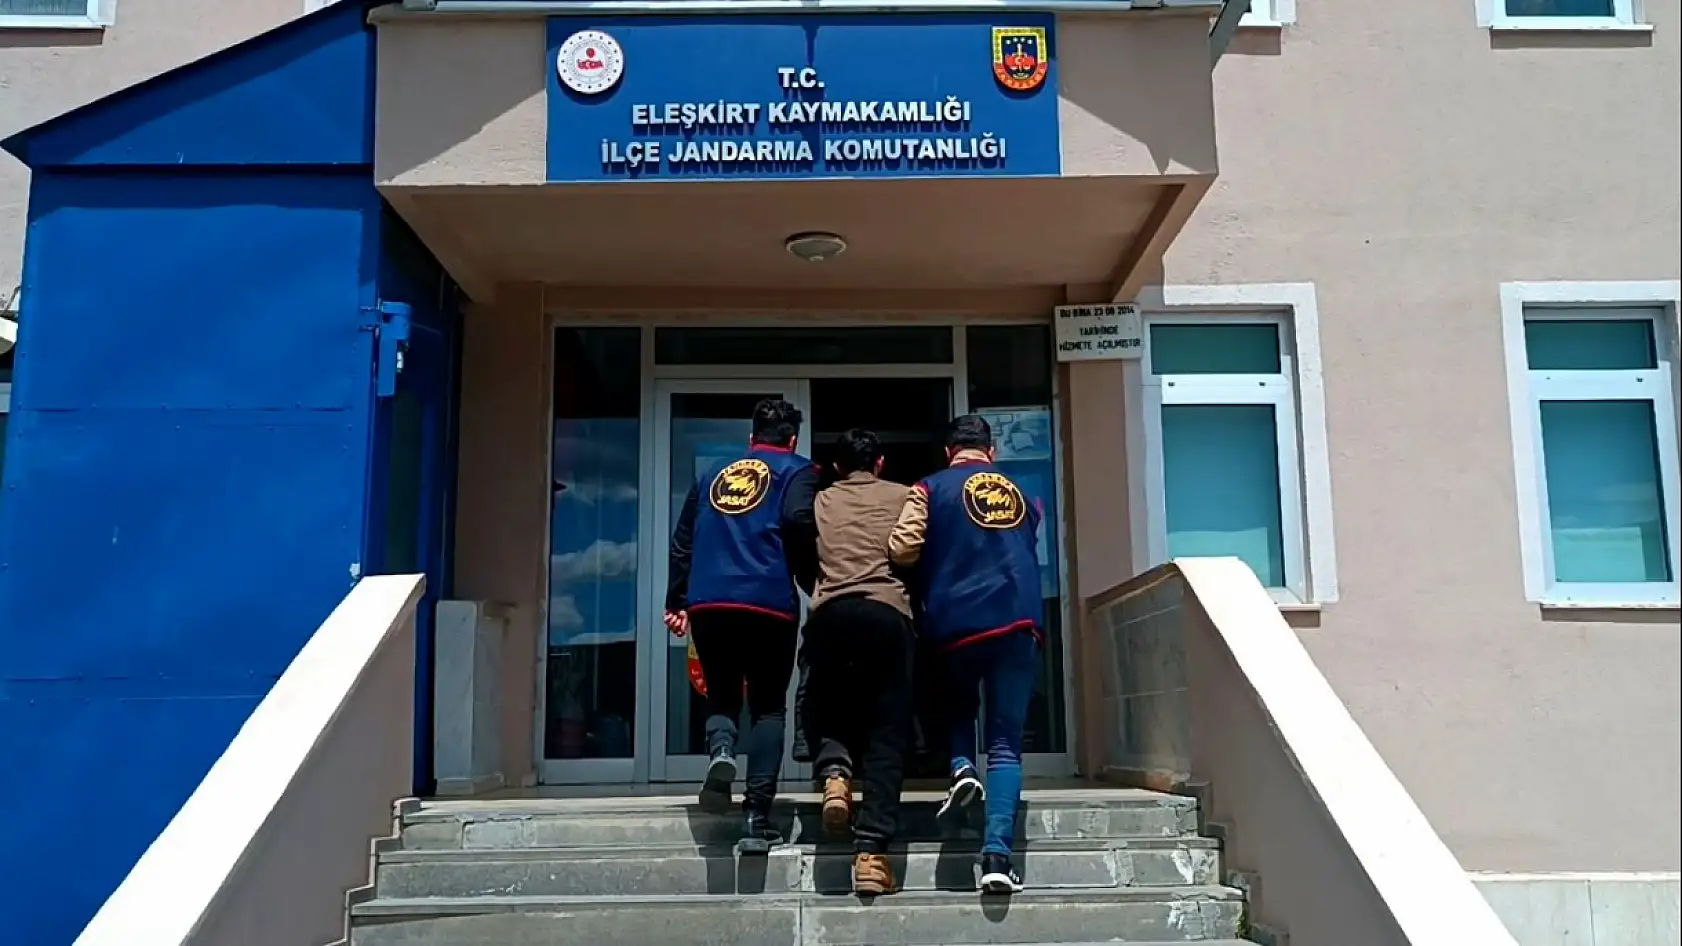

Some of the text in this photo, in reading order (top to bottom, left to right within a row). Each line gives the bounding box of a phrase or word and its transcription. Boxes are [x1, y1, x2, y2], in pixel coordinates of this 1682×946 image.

[778, 67, 825, 88] T.C.
[632, 95, 971, 128] ELEŞKİRT KAYMAKAMLIĞI
[601, 132, 1006, 167] İLÇE JANDARMA KOMUTANLIĞI
[717, 494, 749, 506] JASAT
